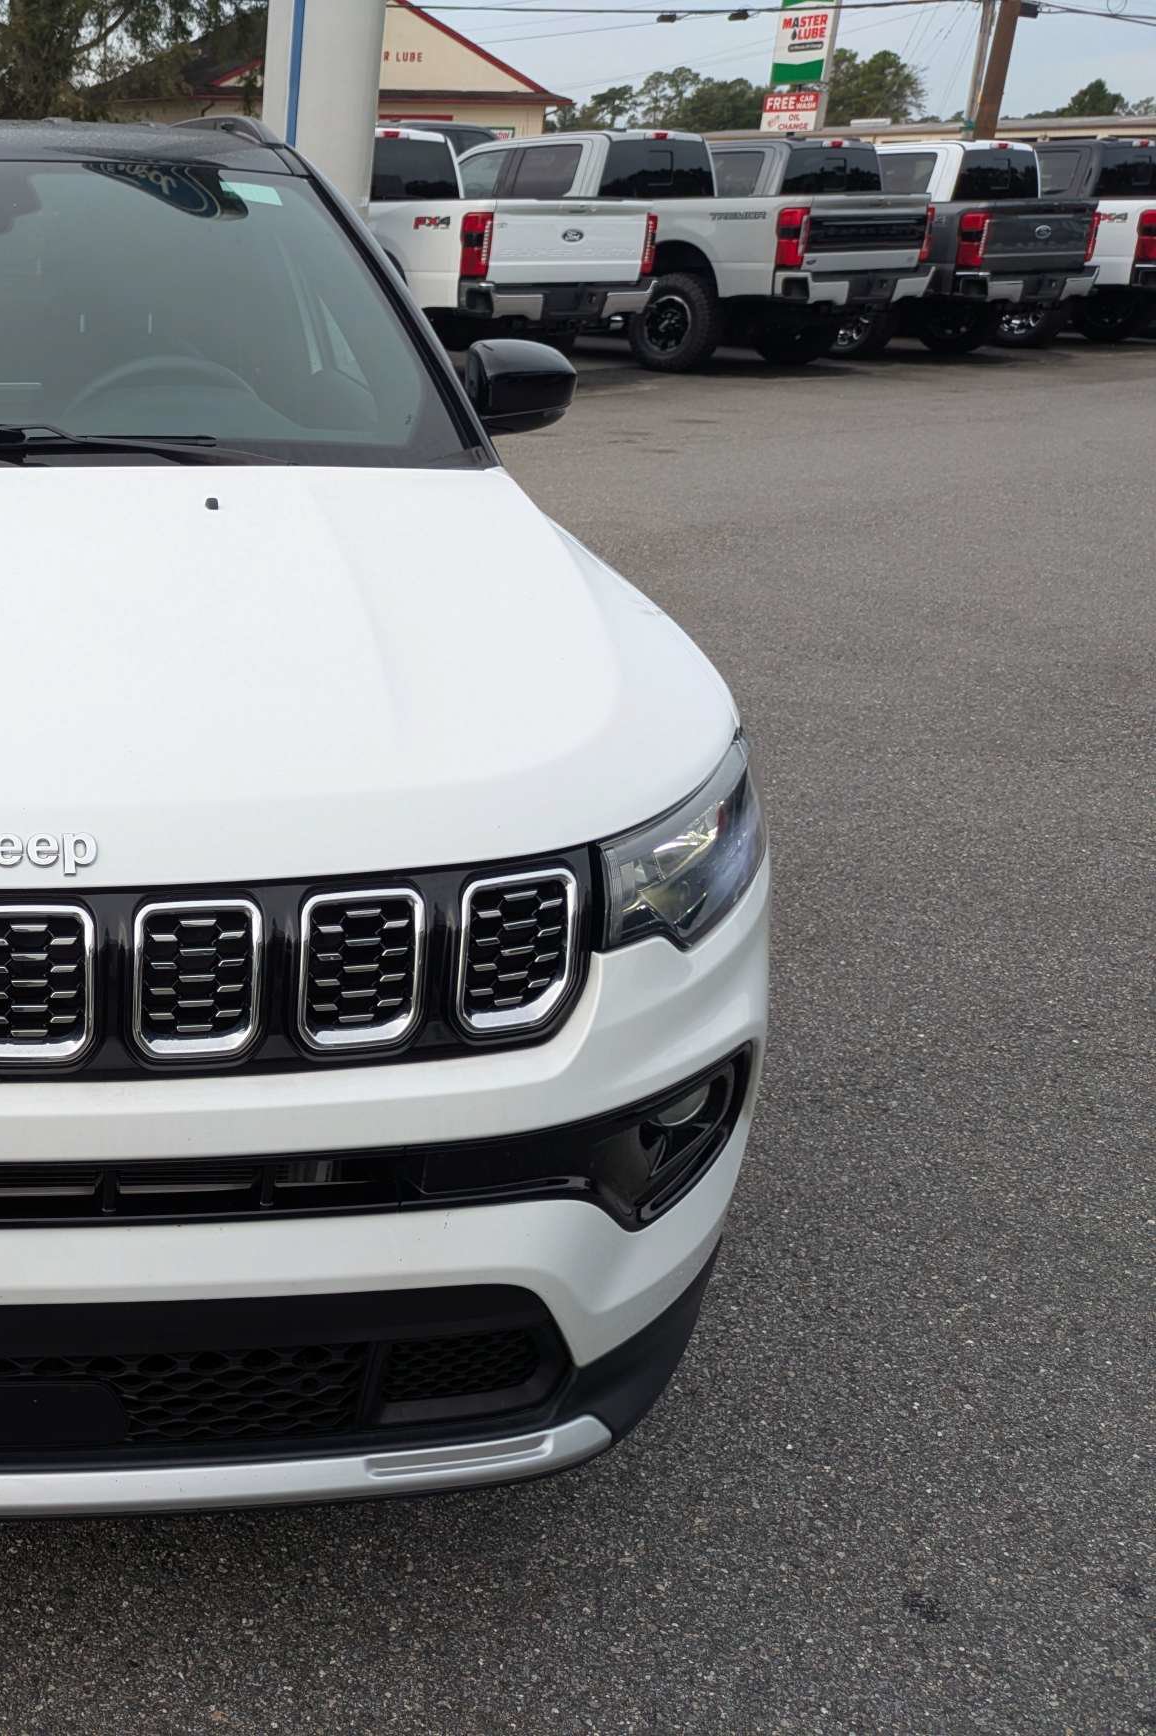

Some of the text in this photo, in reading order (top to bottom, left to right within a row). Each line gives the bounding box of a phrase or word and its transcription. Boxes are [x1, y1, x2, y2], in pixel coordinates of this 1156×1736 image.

[782, 14, 829, 29] MASTER
[797, 27, 826, 40] LUBE
[396, 51, 423, 62] LUBE
[766, 96, 797, 110] FREE
[709, 211, 766, 220] TREMOR
[413, 216, 451, 230] FX4
